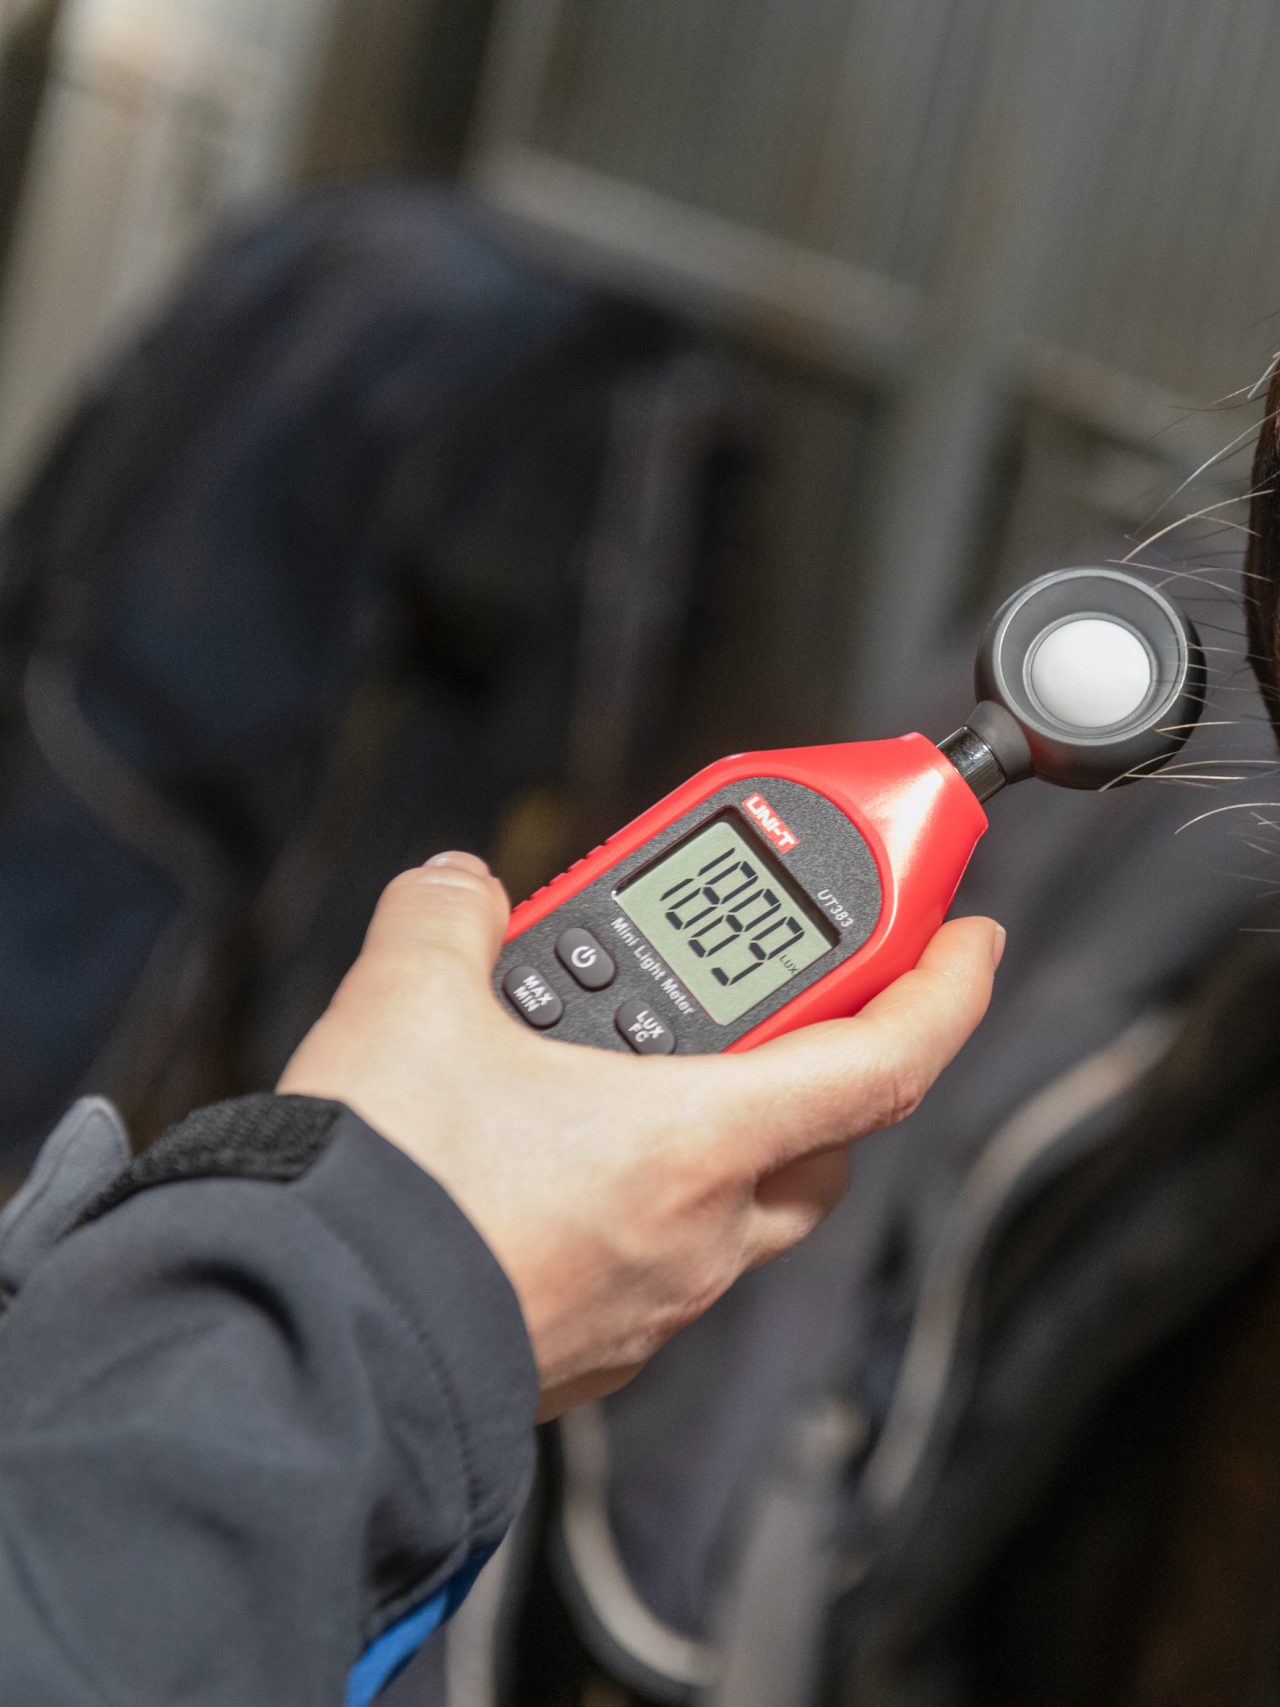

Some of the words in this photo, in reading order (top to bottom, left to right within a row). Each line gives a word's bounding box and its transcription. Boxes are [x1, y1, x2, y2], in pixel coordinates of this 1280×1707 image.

[746, 796, 796, 846] UNI-T
[659, 847, 805, 986] 1889
[779, 954, 798, 974] LUX
[817, 889, 854, 927] UT383
[611, 917, 638, 947] Mini
[633, 945, 667, 981] Light
[660, 978, 696, 1015] Meter
[513, 985, 541, 1012] MIN
[522, 974, 554, 1006] MAX
[628, 1023, 650, 1043] FC
[636, 1010, 665, 1039] LUX
